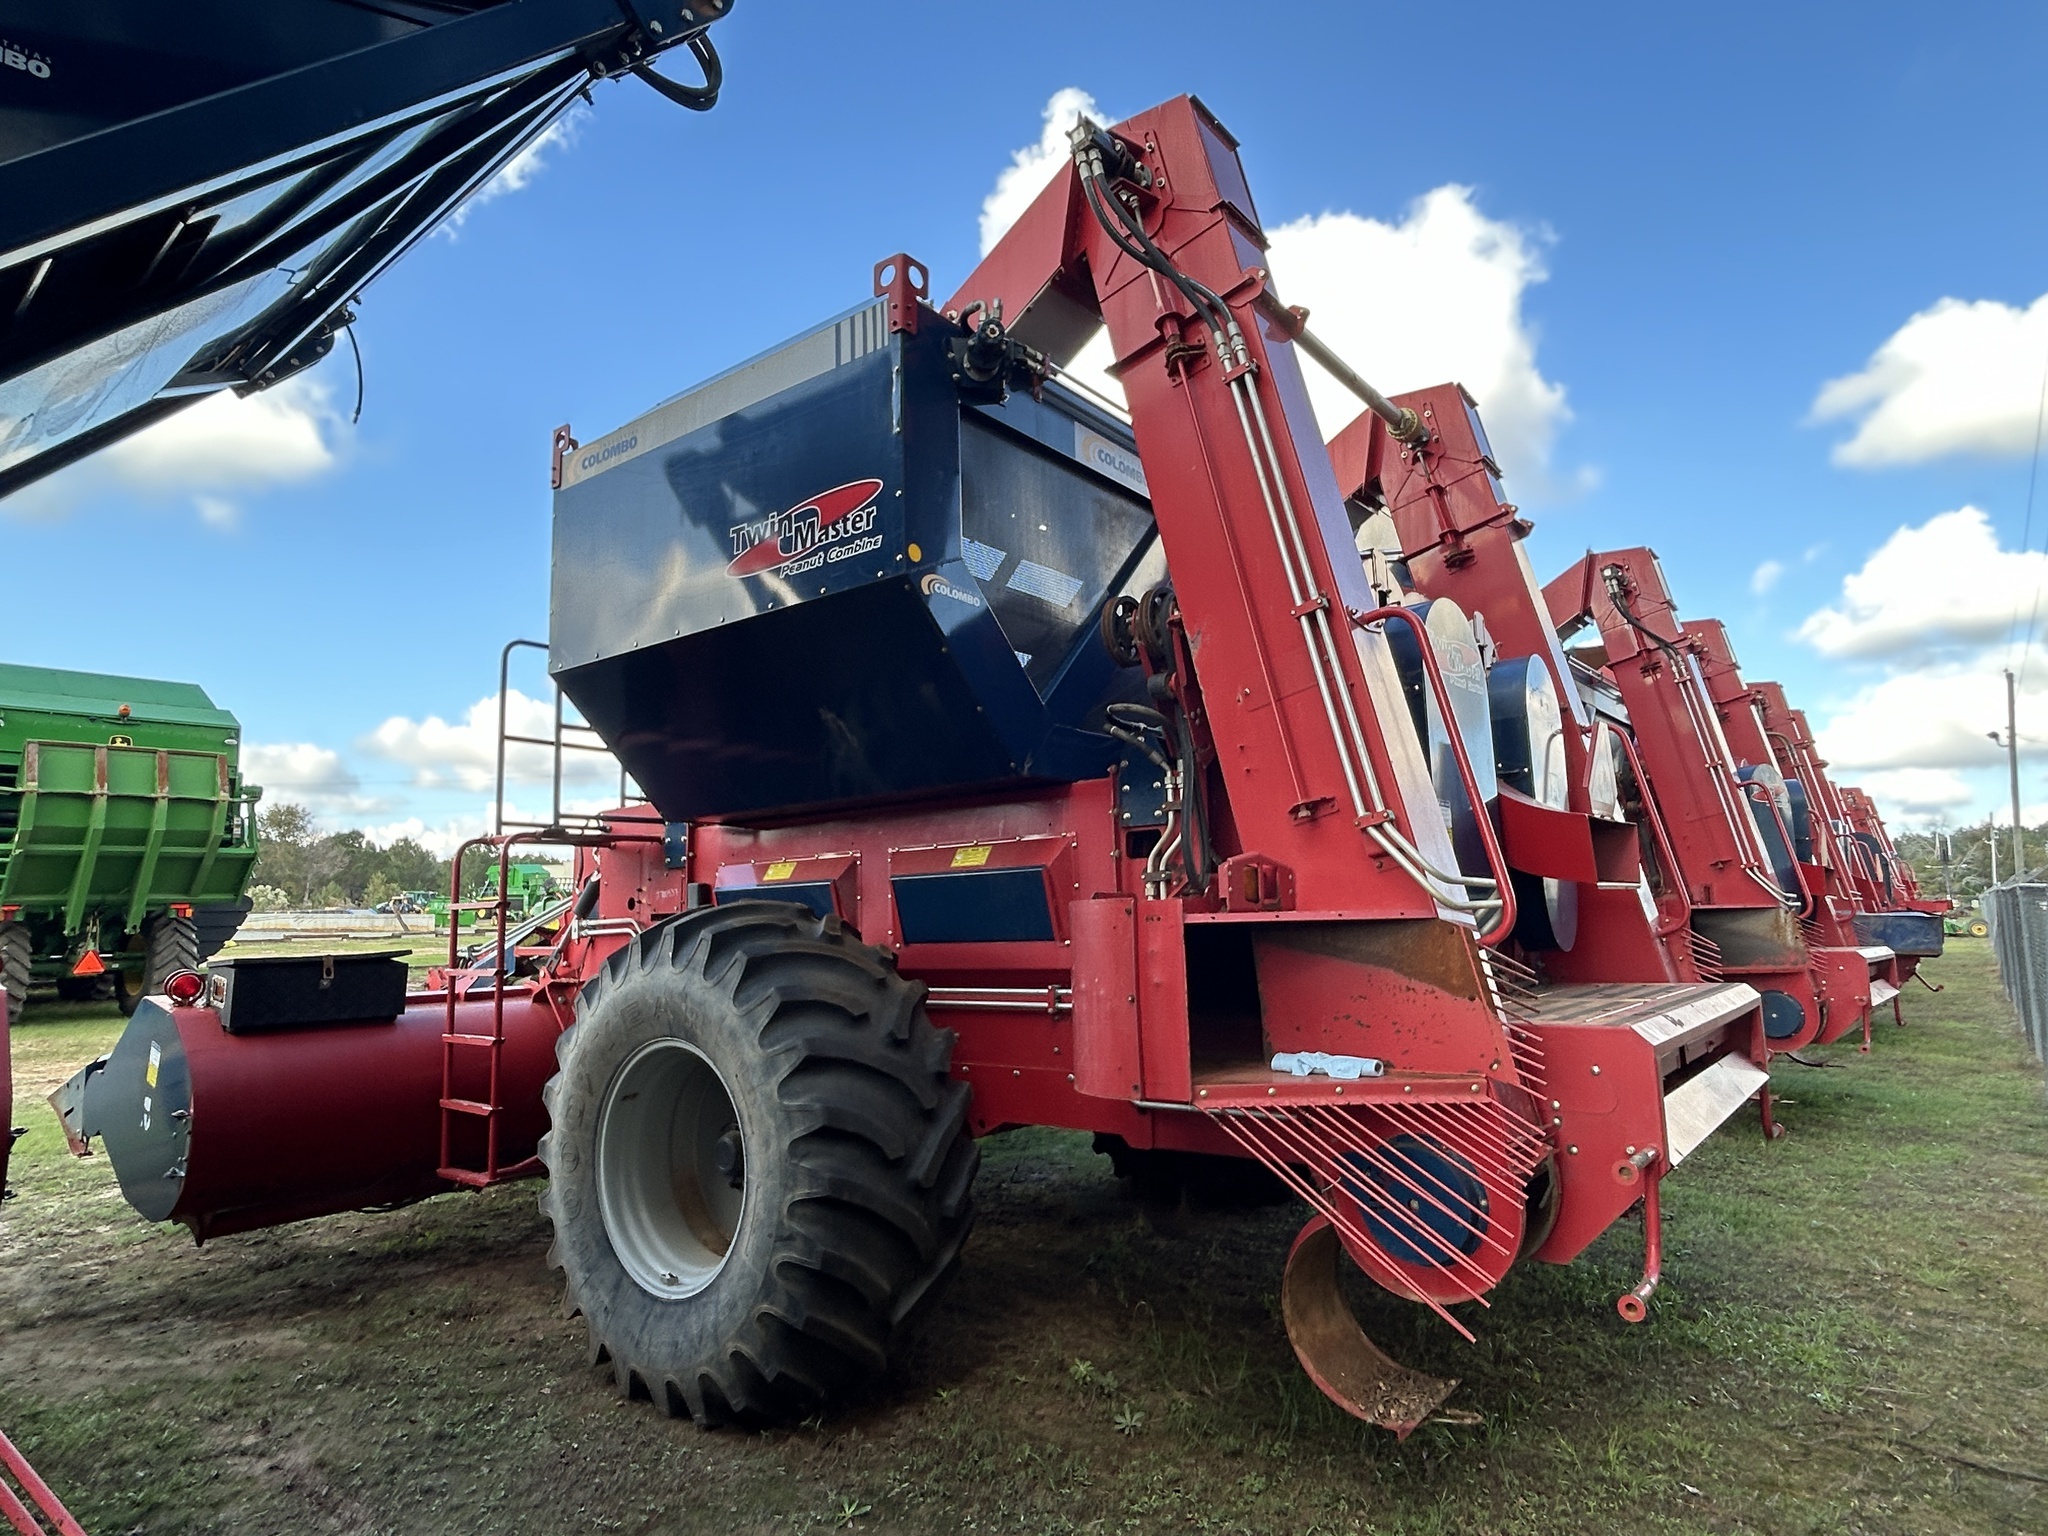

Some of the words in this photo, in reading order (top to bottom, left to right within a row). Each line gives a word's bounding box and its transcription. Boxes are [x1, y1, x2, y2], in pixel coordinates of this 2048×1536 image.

[581, 435, 638, 470] COLOMBO
[1097, 448, 1144, 484] COLOMB
[730, 511, 794, 556] Twin
[792, 506, 877, 554] Master
[779, 552, 824, 578] Peanut
[826, 535, 883, 563] Combine
[933, 582, 980, 607] COLOMBO
